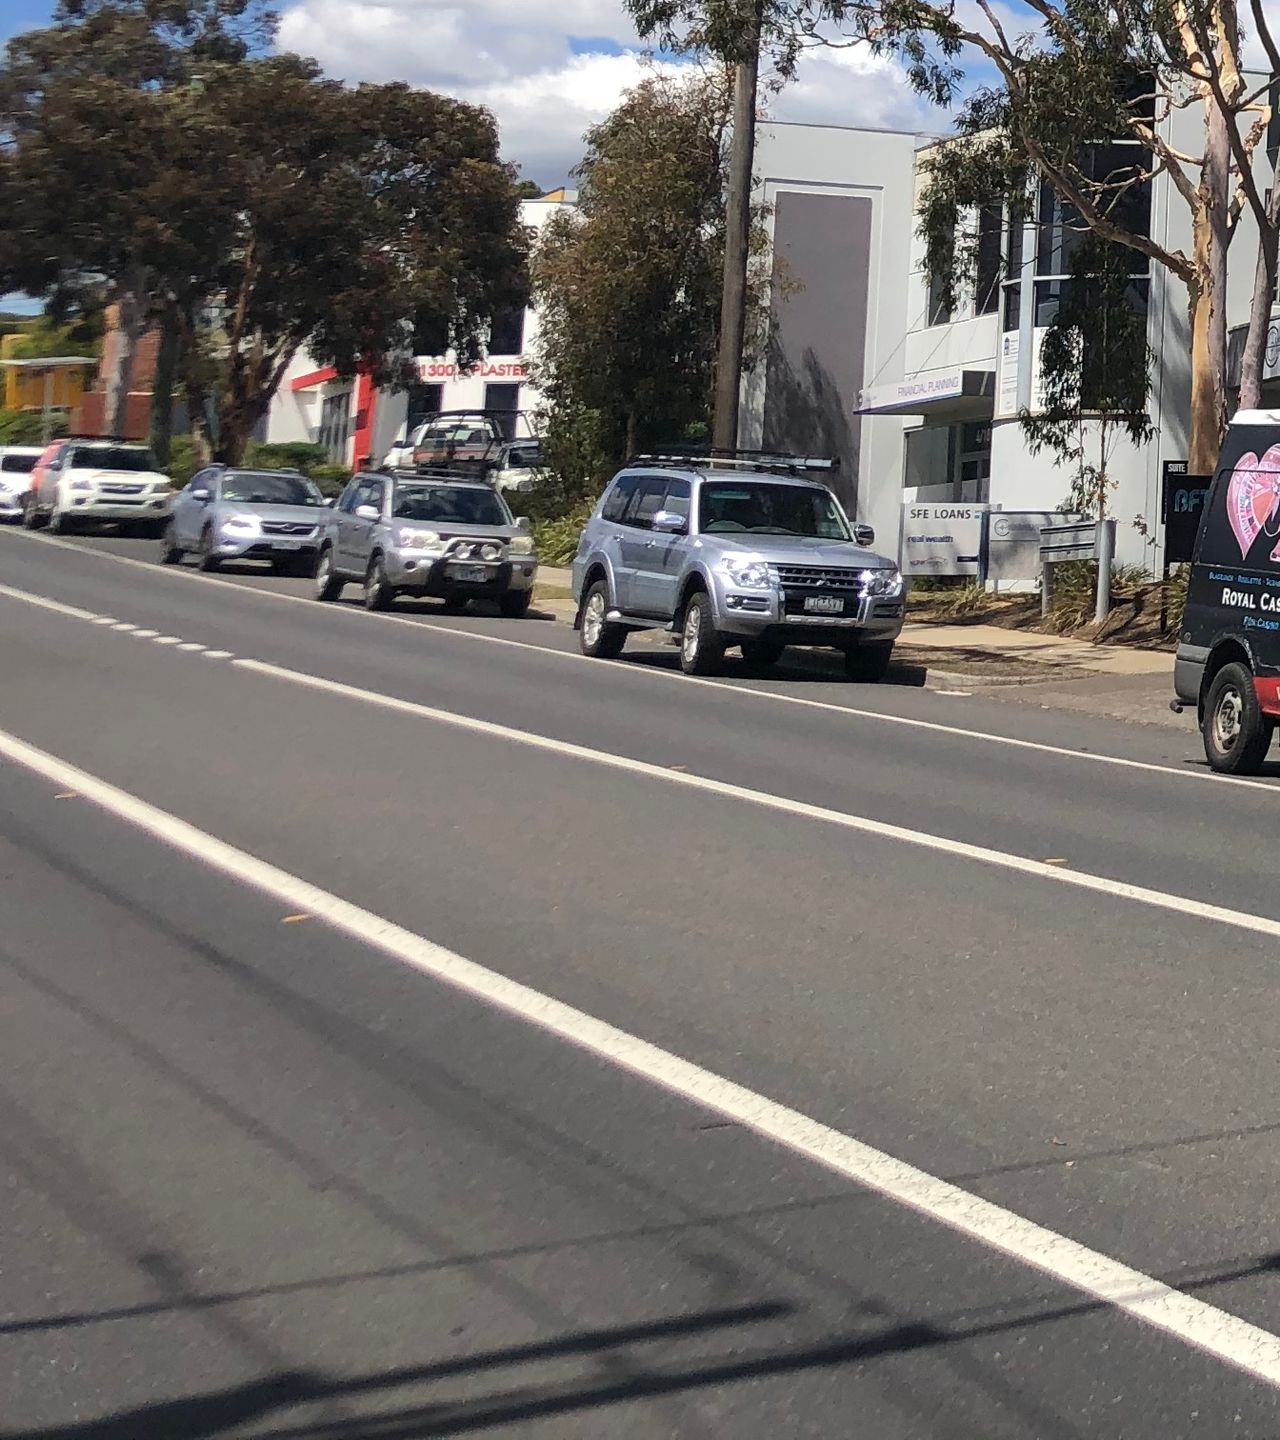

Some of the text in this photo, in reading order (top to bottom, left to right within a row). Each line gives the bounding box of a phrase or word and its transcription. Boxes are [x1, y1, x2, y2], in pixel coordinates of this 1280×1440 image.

[422, 364, 454, 377] 1300
[897, 376, 959, 398] FINANCIAL PLANNING
[1167, 463, 1186, 472] SUITE
[910, 509, 971, 519] SFE LOANS
[1221, 587, 1256, 609] ROYAL
